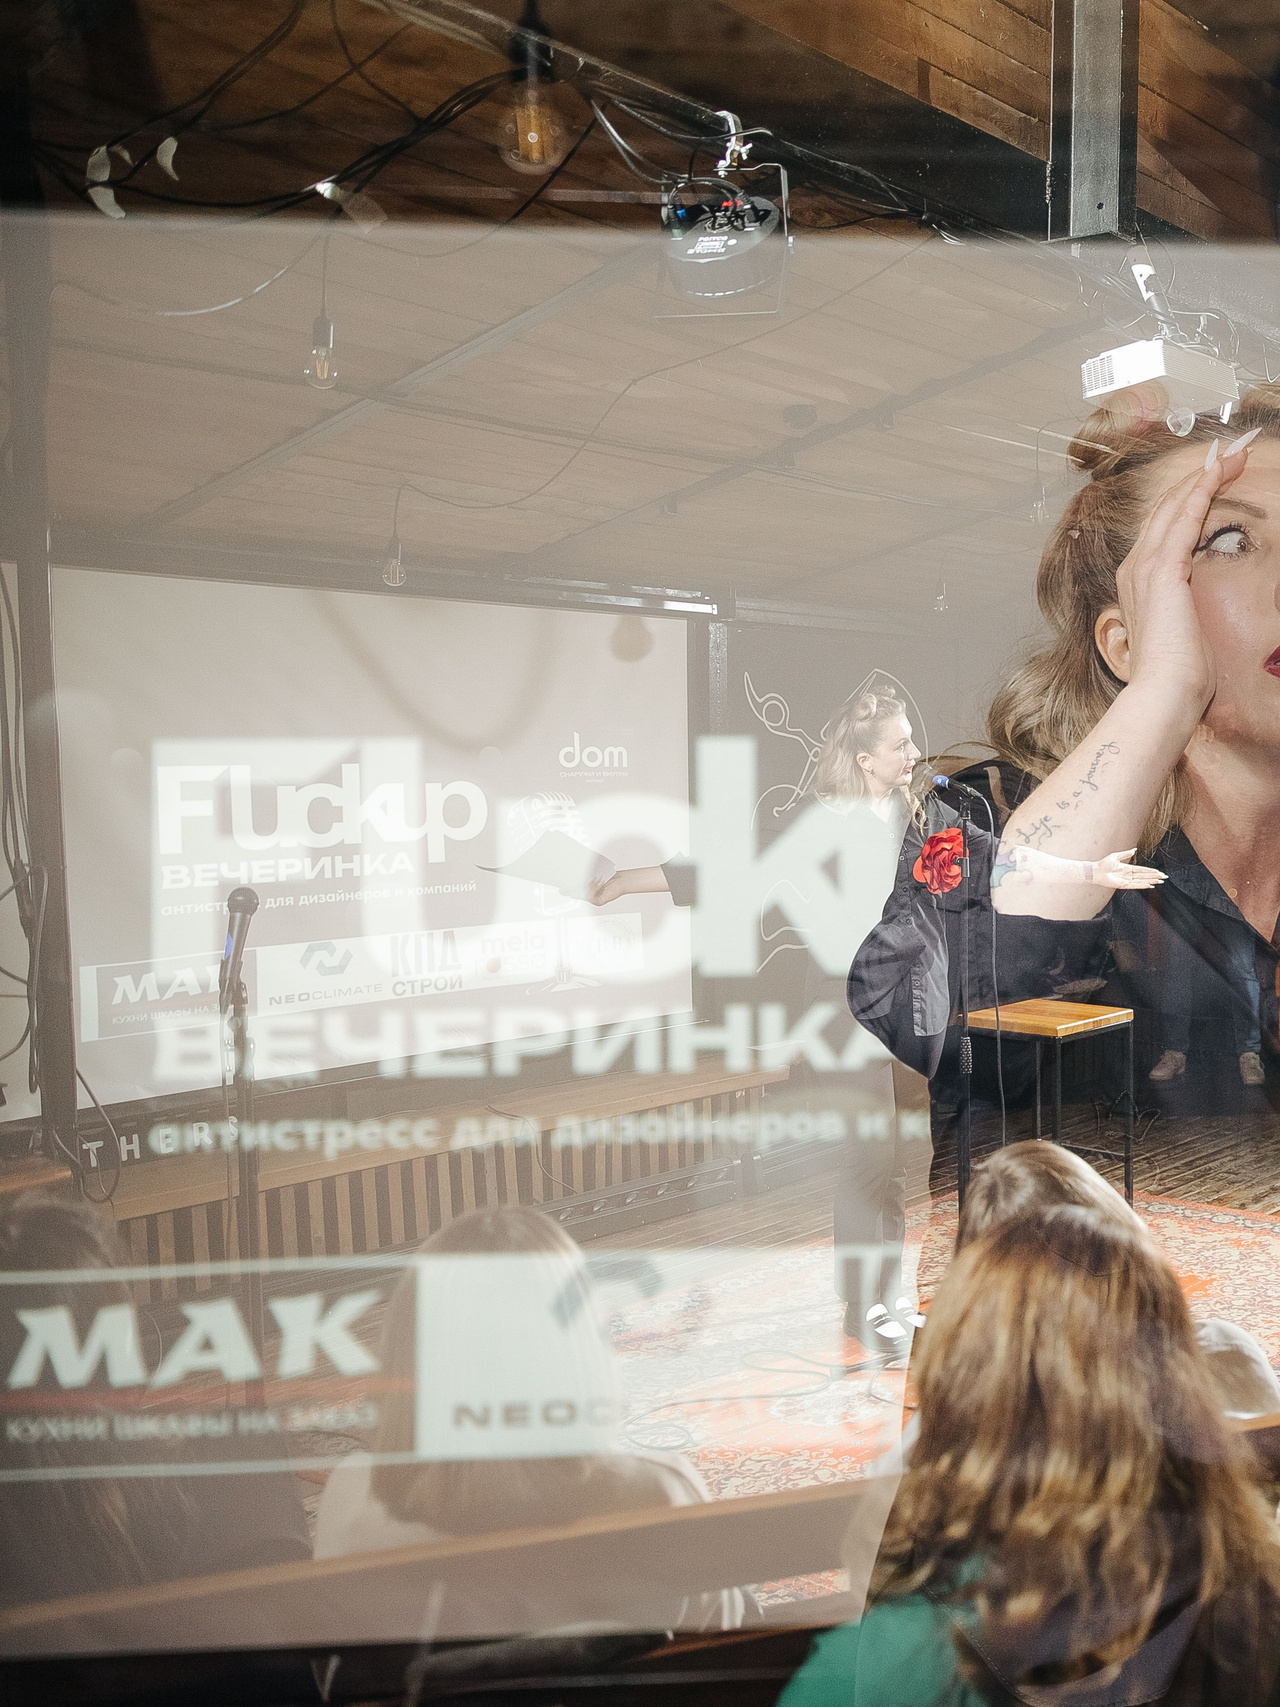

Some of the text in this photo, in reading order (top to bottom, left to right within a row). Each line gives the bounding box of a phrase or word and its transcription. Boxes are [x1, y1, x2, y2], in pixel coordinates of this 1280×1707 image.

[558, 731, 628, 768] dom
[1016, 815, 1052, 844] Life
[161, 851, 417, 890] ВЕЧЕРИНКА
[161, 900, 230, 917] антистр
[264, 894, 294, 910] для
[298, 886, 391, 907] дизайнеров
[407, 879, 478, 898] компаний
[391, 930, 463, 978] КПД
[481, 930, 546, 954] mela
[269, 983, 384, 1006] NEOCLIMATE
[392, 974, 464, 997] СТРОЙ
[112, 1013, 149, 1025] КУХНИ
[151, 1008, 192, 1020] ШКАФЫ
[195, 1006, 210, 1015] НА
